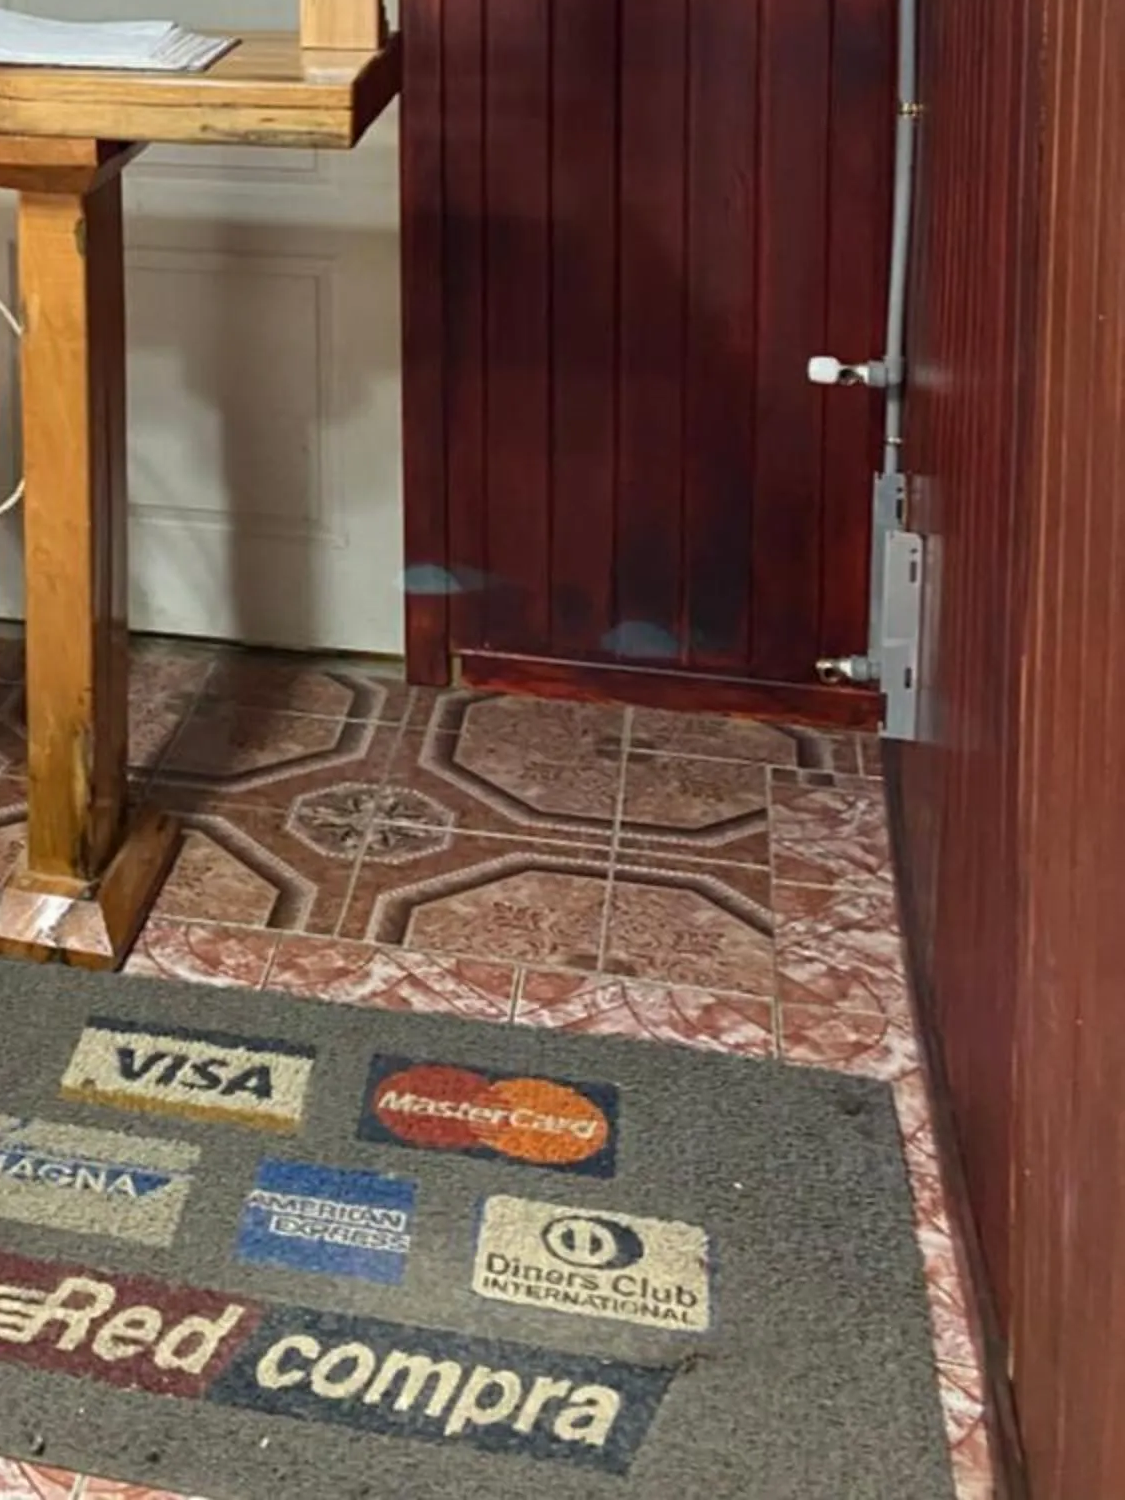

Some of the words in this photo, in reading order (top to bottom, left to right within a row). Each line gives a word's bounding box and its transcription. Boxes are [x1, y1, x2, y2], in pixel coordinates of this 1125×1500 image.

[115, 1047, 273, 1099] VISA
[378, 1090, 599, 1141] MasterCard
[247, 1189, 407, 1233] AMERICAN
[270, 1216, 411, 1253] EXPRESS
[482, 1276, 699, 1326] INTERNATIONAL
[485, 1252, 600, 1293] Diners
[611, 1273, 699, 1310] Club
[19, 1274, 246, 1375] Red
[255, 1332, 621, 1446] compra
